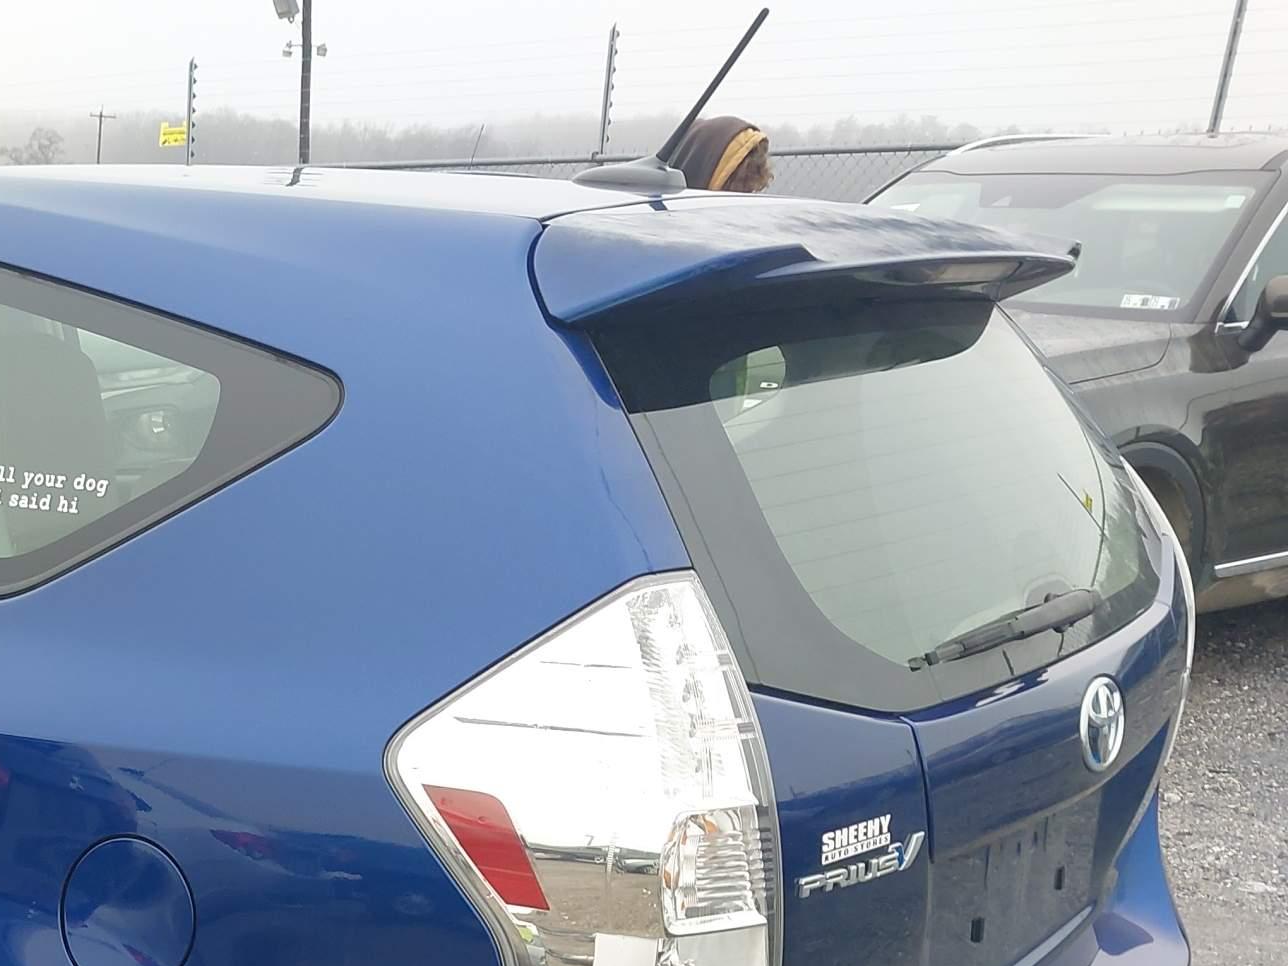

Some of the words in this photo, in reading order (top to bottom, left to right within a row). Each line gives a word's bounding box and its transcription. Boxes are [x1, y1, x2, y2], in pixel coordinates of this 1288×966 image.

[21, 471, 67, 489] your
[73, 473, 110, 497] dog
[8, 492, 52, 511] said
[57, 495, 80, 514] hi
[821, 813, 892, 853] SHEEHY
[824, 848, 850, 862] AUTO
[854, 835, 890, 853] STORES
[796, 852, 899, 899] PRIUS
